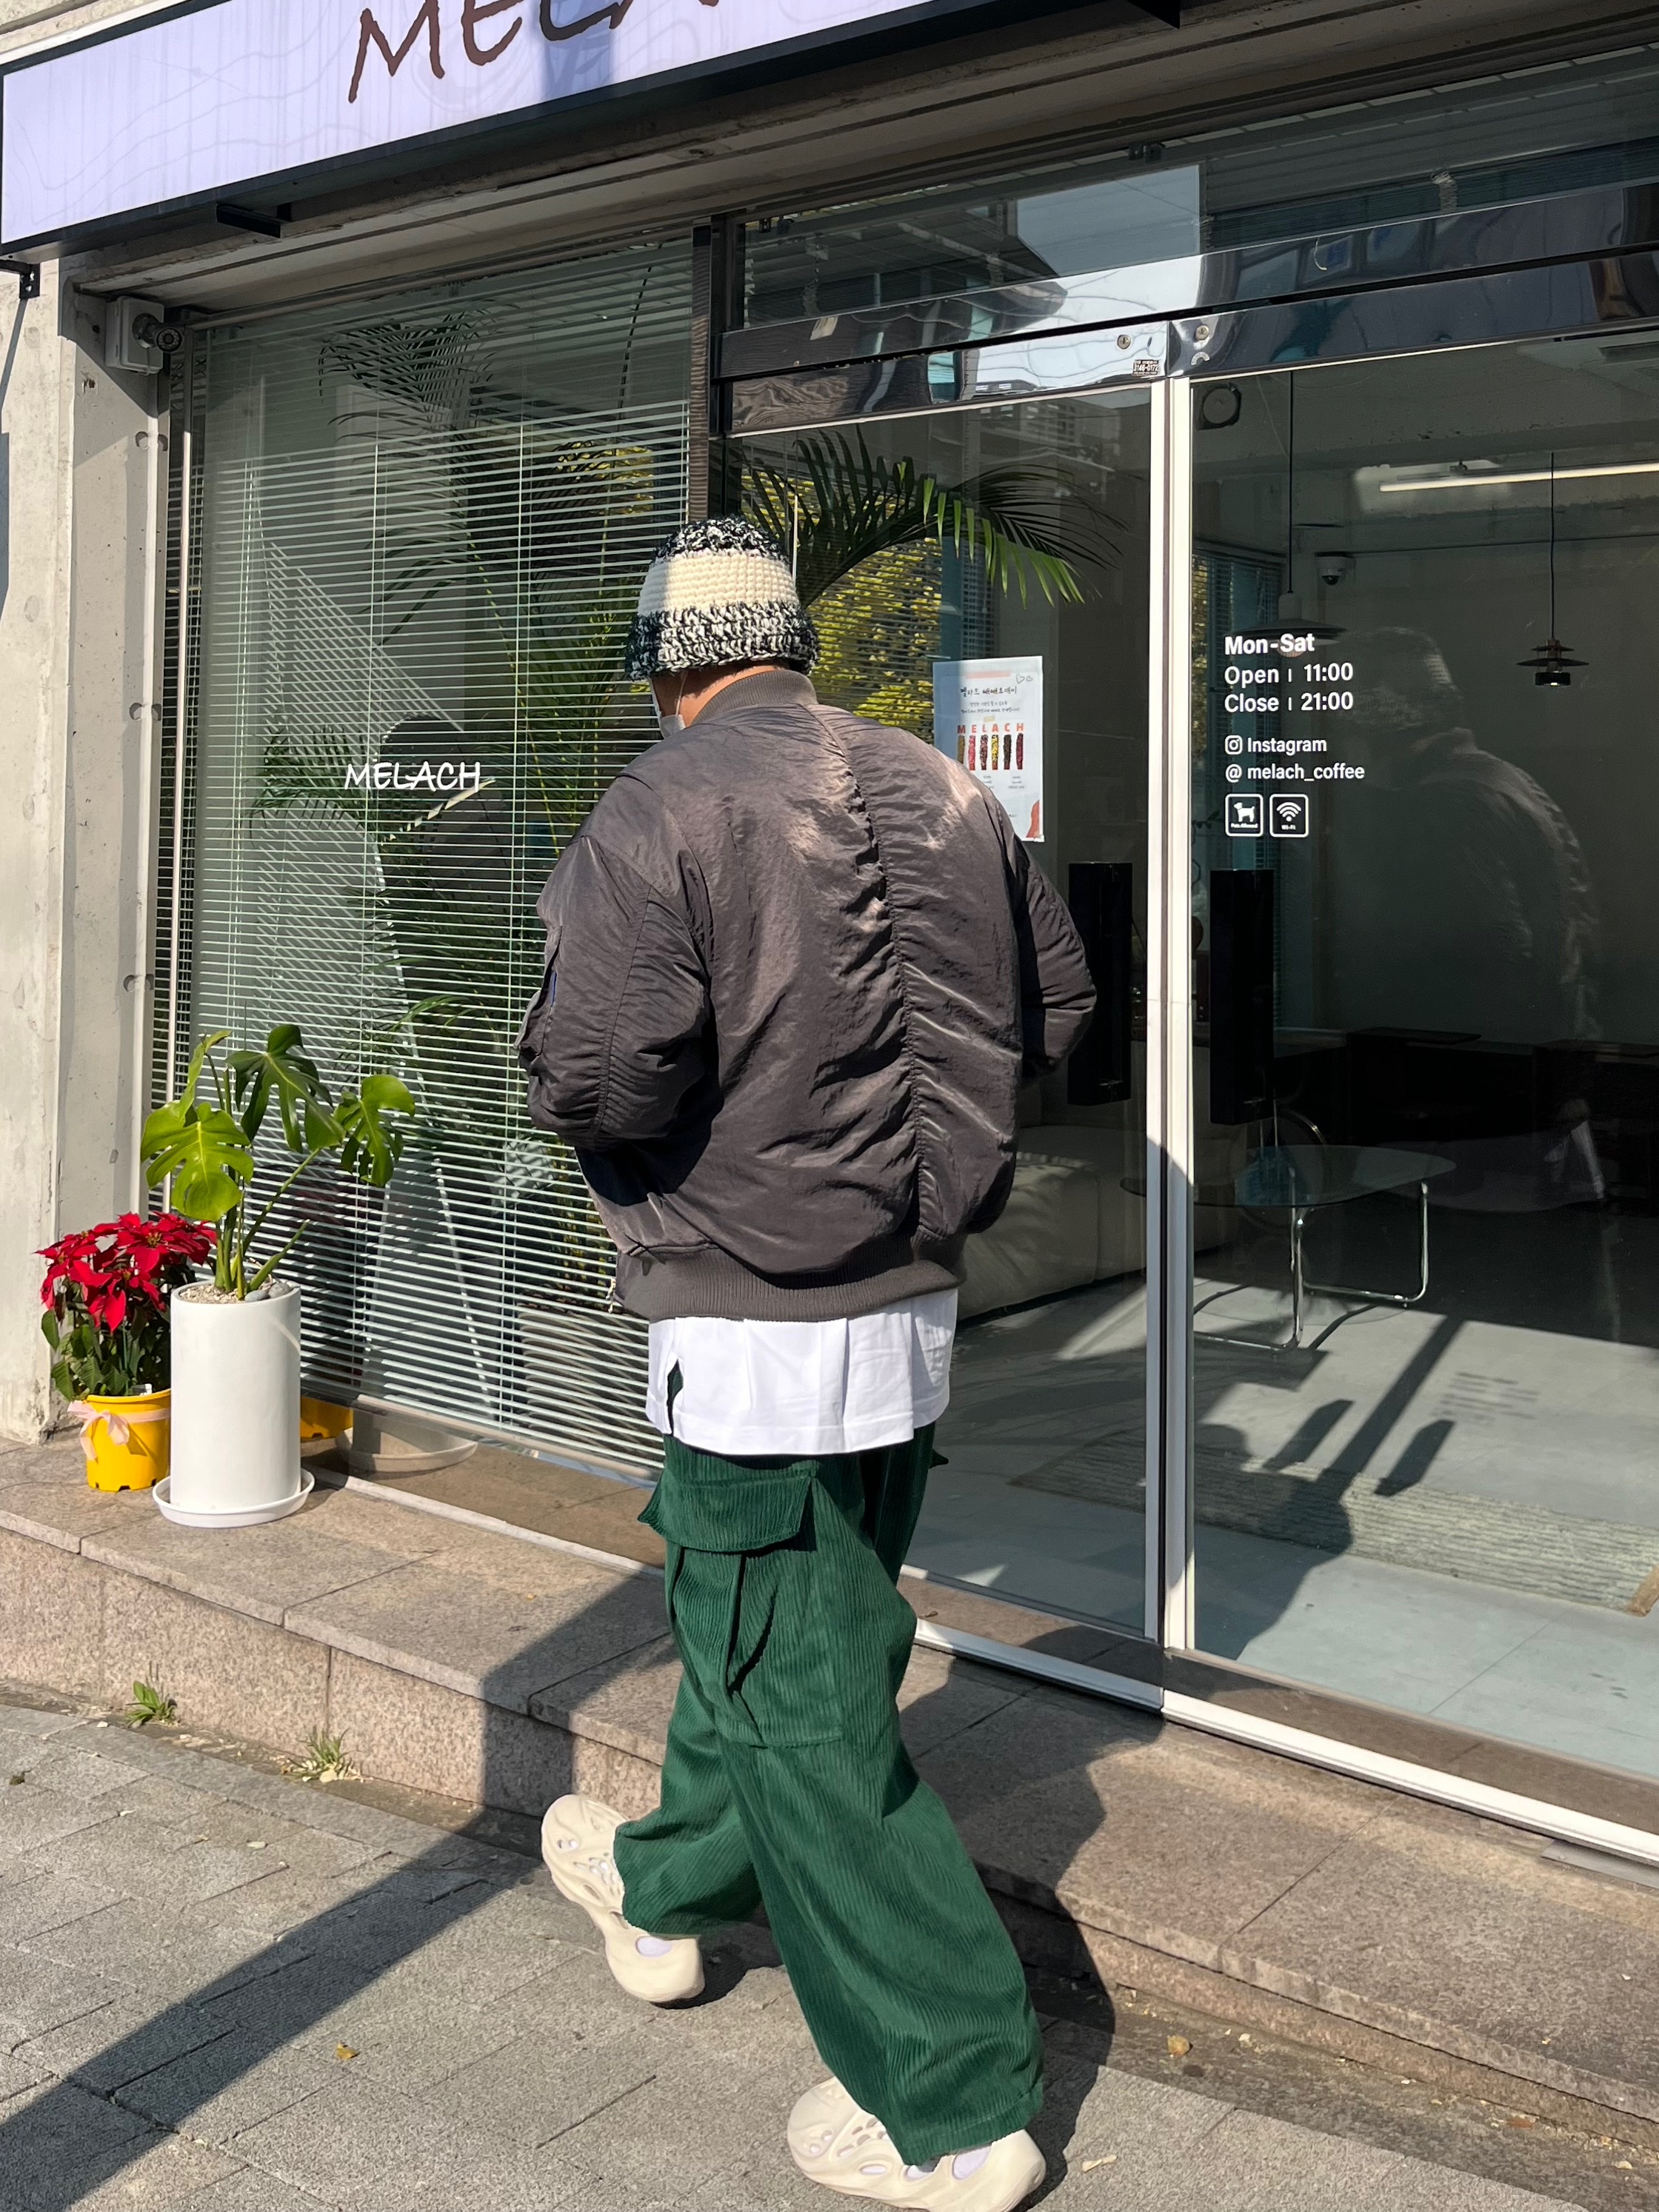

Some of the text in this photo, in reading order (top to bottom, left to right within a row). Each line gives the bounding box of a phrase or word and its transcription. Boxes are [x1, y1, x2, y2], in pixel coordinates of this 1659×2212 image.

[1224, 666, 1280, 689] Open
[1304, 662, 1354, 682] 11:00
[1224, 694, 1279, 712] Close
[1301, 692, 1354, 711] 21:00
[957, 723, 1025, 734] MELACH
[1247, 737, 1327, 756] Instagram
[344, 761, 481, 792] MELACH
[1247, 762, 1365, 782] melach_coffee
